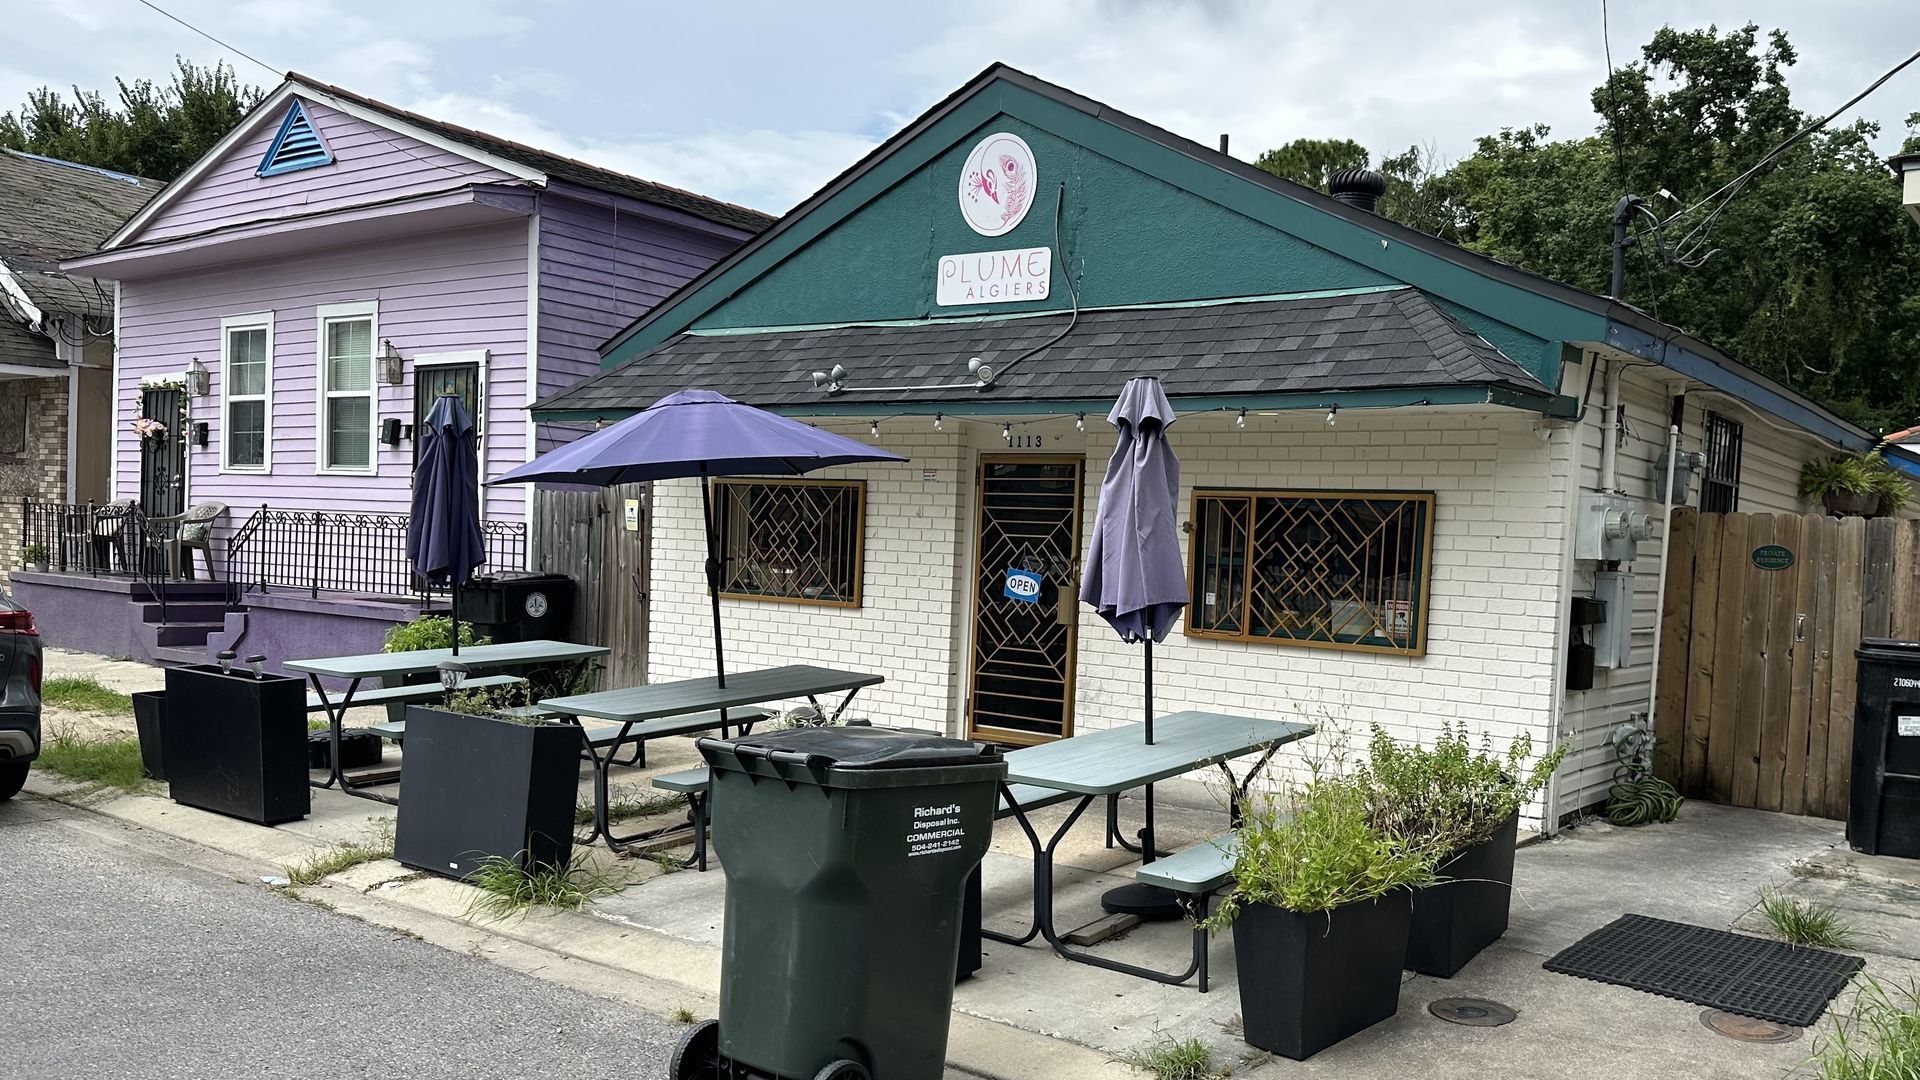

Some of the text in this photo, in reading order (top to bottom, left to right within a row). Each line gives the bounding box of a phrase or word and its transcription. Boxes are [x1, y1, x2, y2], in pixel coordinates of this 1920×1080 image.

[942, 251, 1046, 286] PLUME
[966, 281, 1046, 299] ALGIERS
[475, 382, 483, 451] 1117
[1009, 435, 1042, 448] 1113
[1010, 578, 1036, 593] OPEN
[914, 804, 961, 818] Richard's
[913, 817, 960, 830] Disposal Inc.
[906, 828, 965, 843] COMMERCIAL
[911, 839, 960, 852] 504-241-2142
